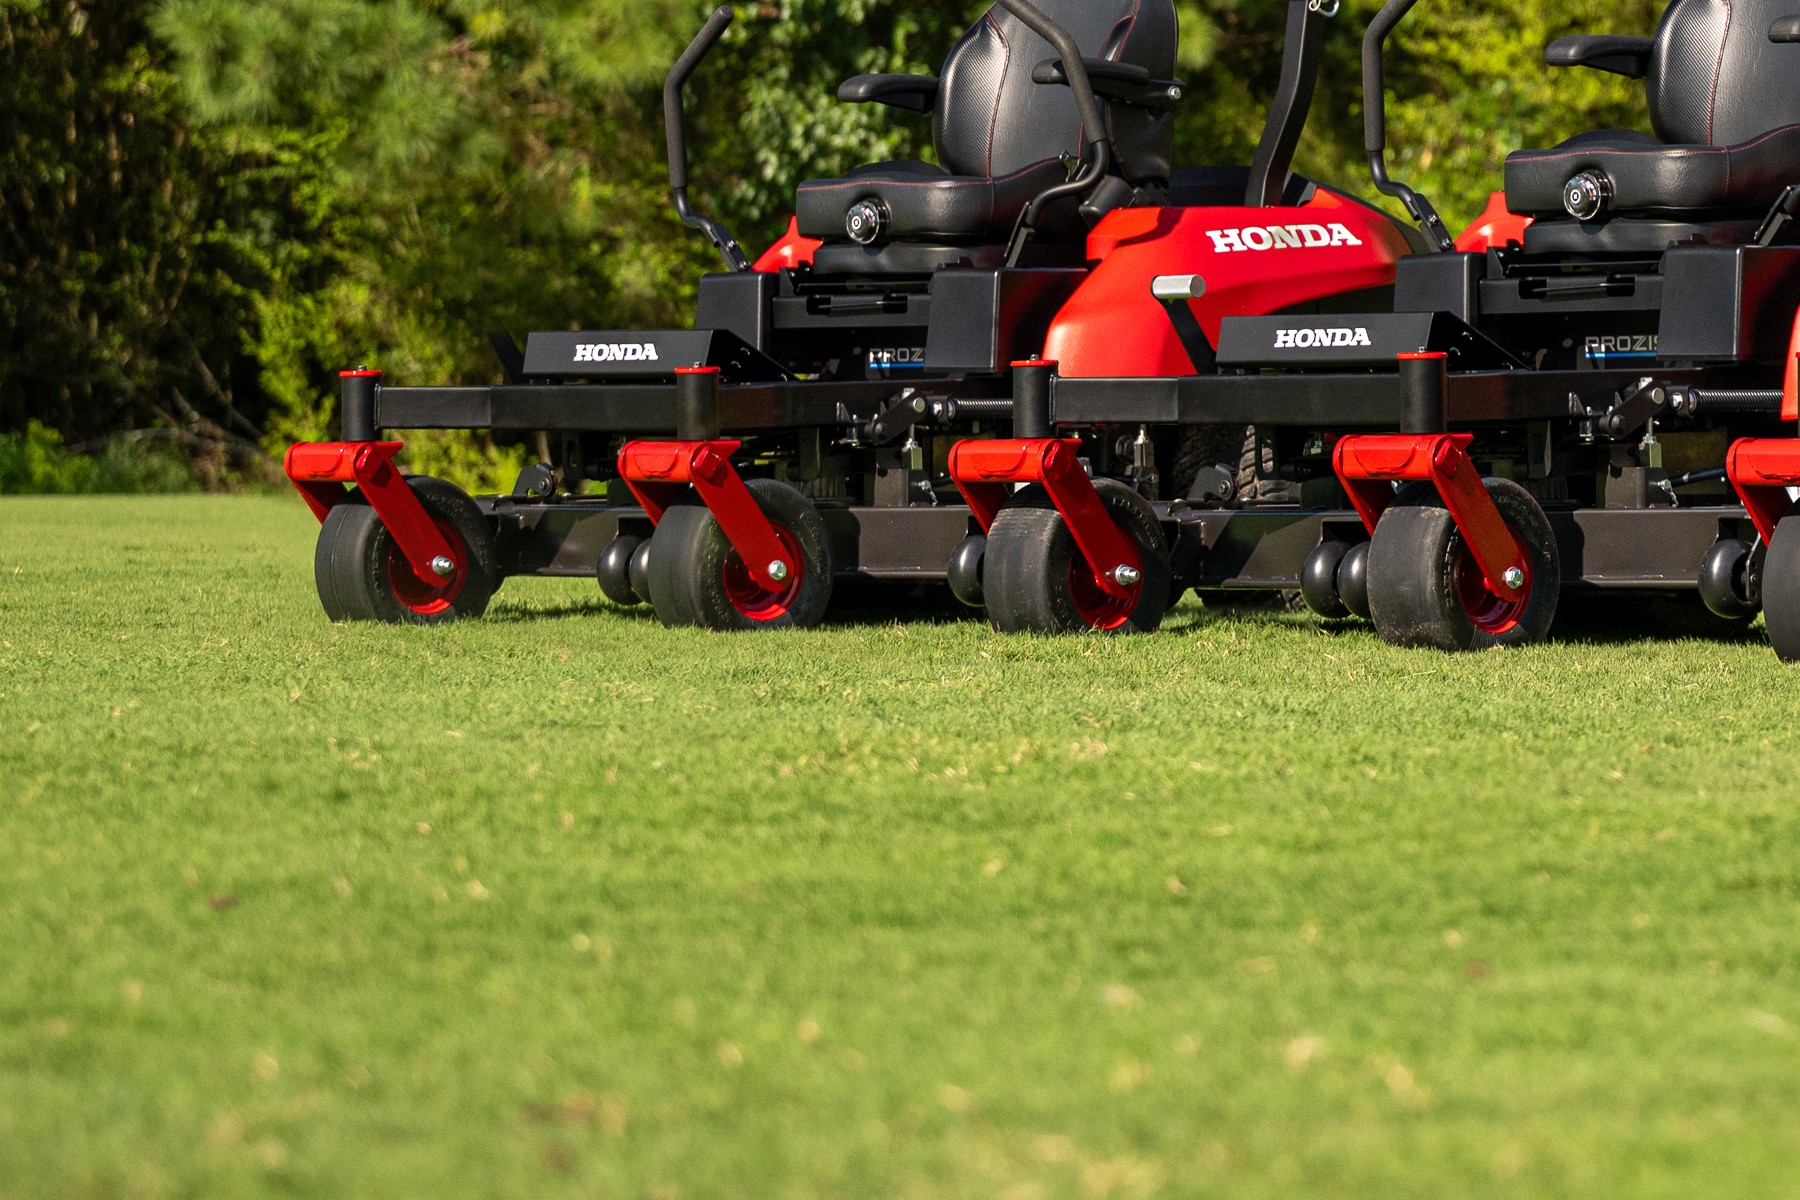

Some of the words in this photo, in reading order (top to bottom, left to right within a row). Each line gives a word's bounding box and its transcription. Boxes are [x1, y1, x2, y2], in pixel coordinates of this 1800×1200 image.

[1206, 223, 1363, 253] HONDA
[1274, 328, 1372, 348] HONDA
[573, 343, 659, 361] HONDA
[869, 348, 926, 363] PROZ
